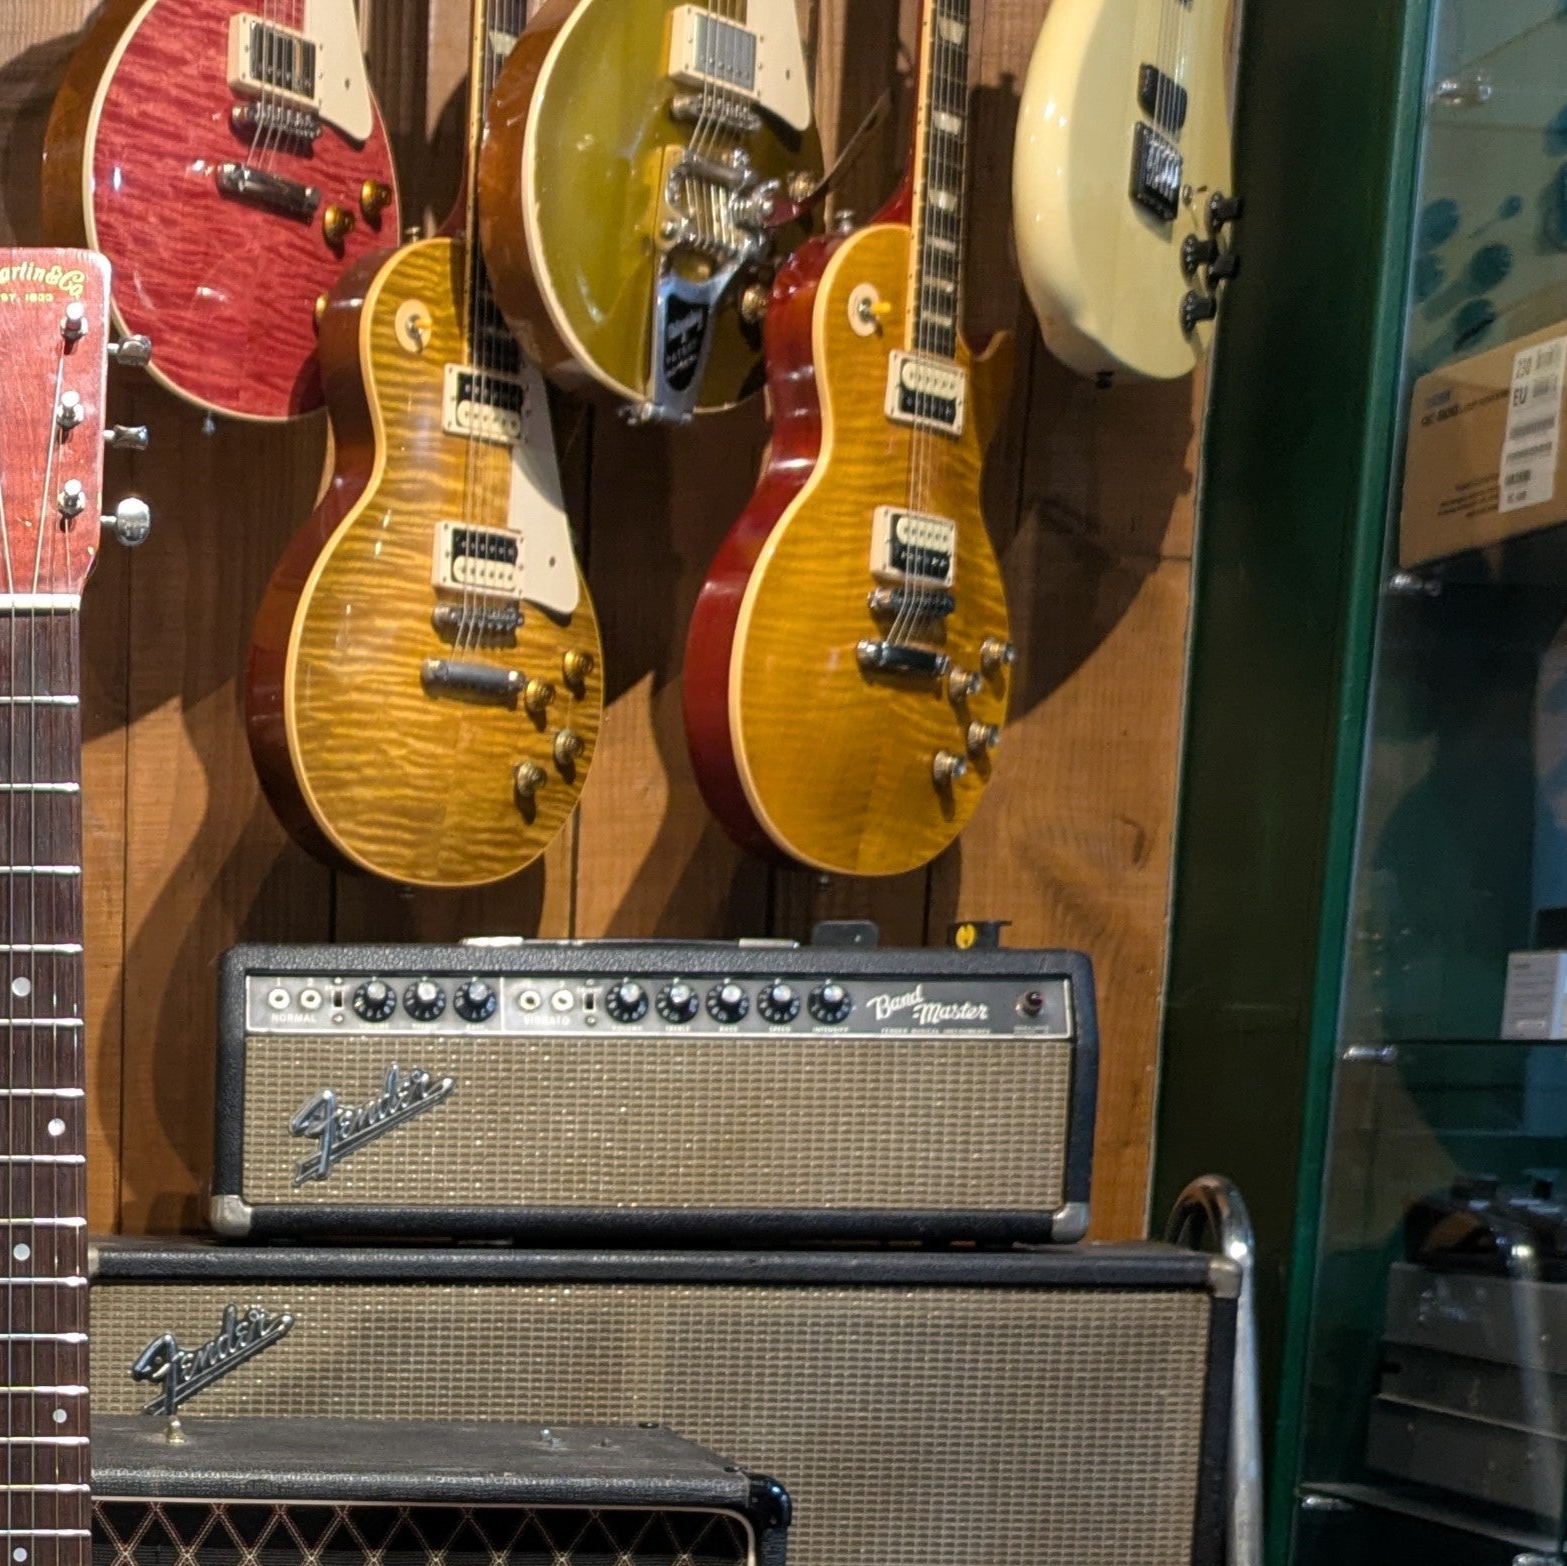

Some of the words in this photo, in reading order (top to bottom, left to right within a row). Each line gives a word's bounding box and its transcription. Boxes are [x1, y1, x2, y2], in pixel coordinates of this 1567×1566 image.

[1512, 385, 1529, 407] EU
[866, 983, 925, 1021] Band
[270, 1012, 317, 1024] NORMAL
[522, 1015, 571, 1026] VIBRATO
[288, 1060, 455, 1187] Fender
[131, 1302, 295, 1415] Fender
